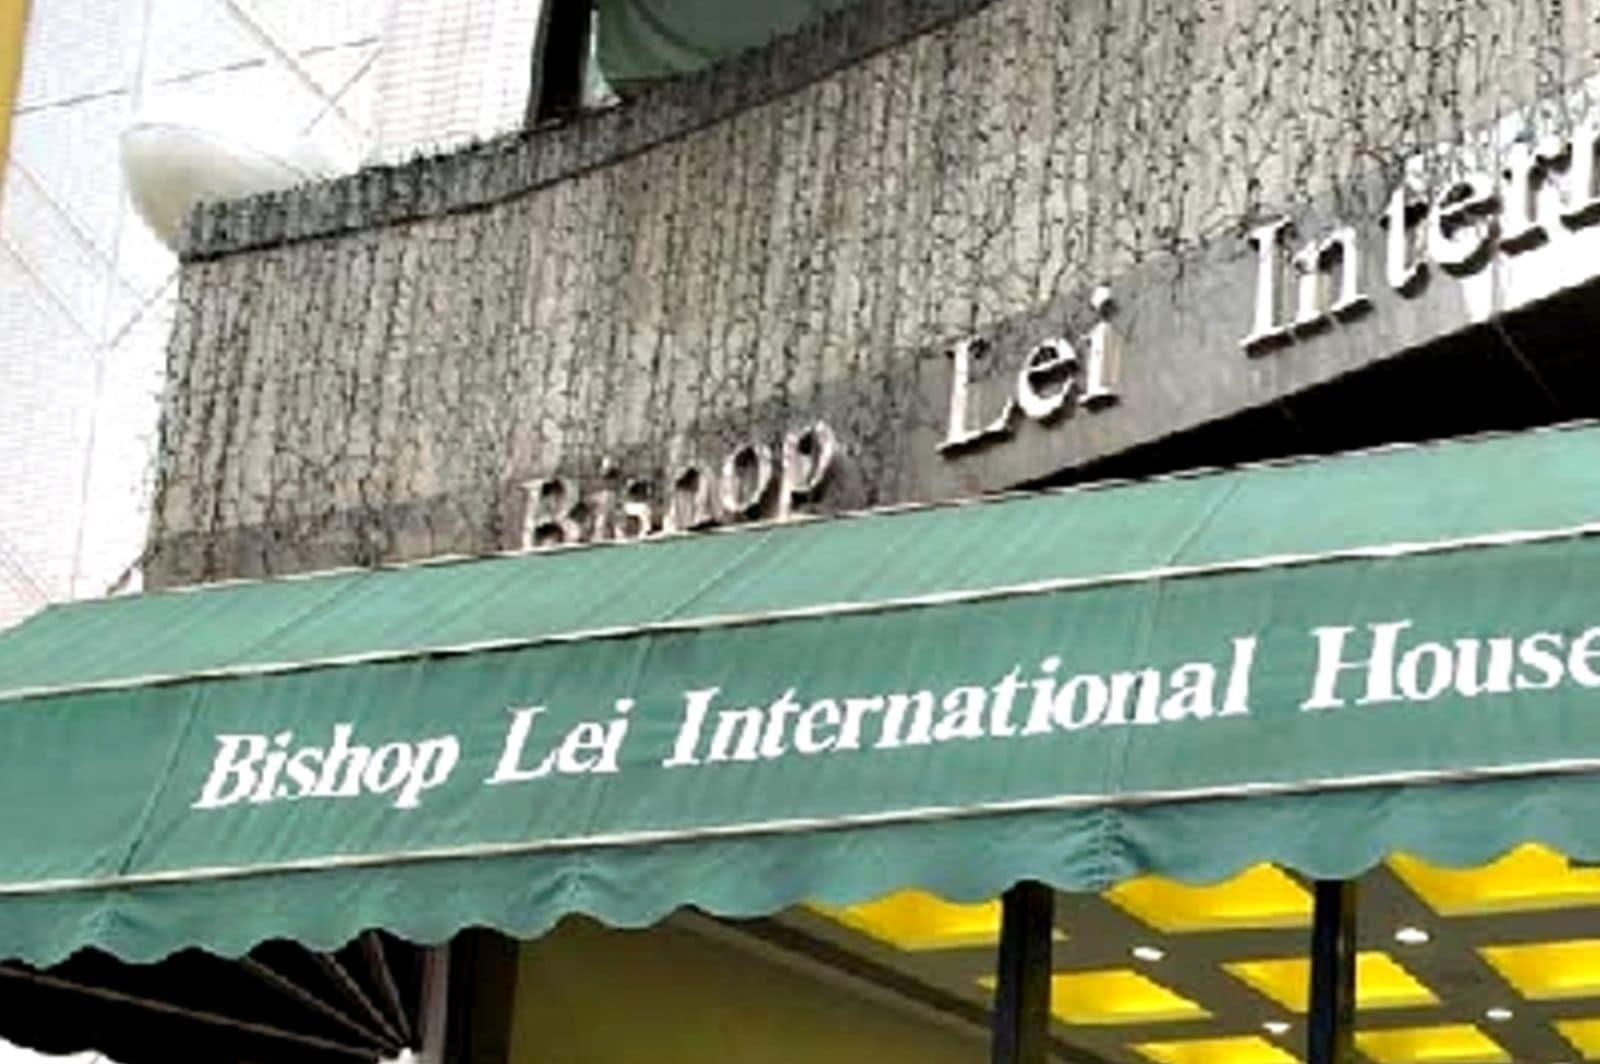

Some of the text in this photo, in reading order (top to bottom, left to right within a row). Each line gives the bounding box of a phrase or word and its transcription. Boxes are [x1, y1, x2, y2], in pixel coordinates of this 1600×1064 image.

[936, 286, 1122, 457] Lei
[192, 724, 460, 808] Bishop
[486, 698, 634, 784] Lei
[662, 636, 1257, 769] International
